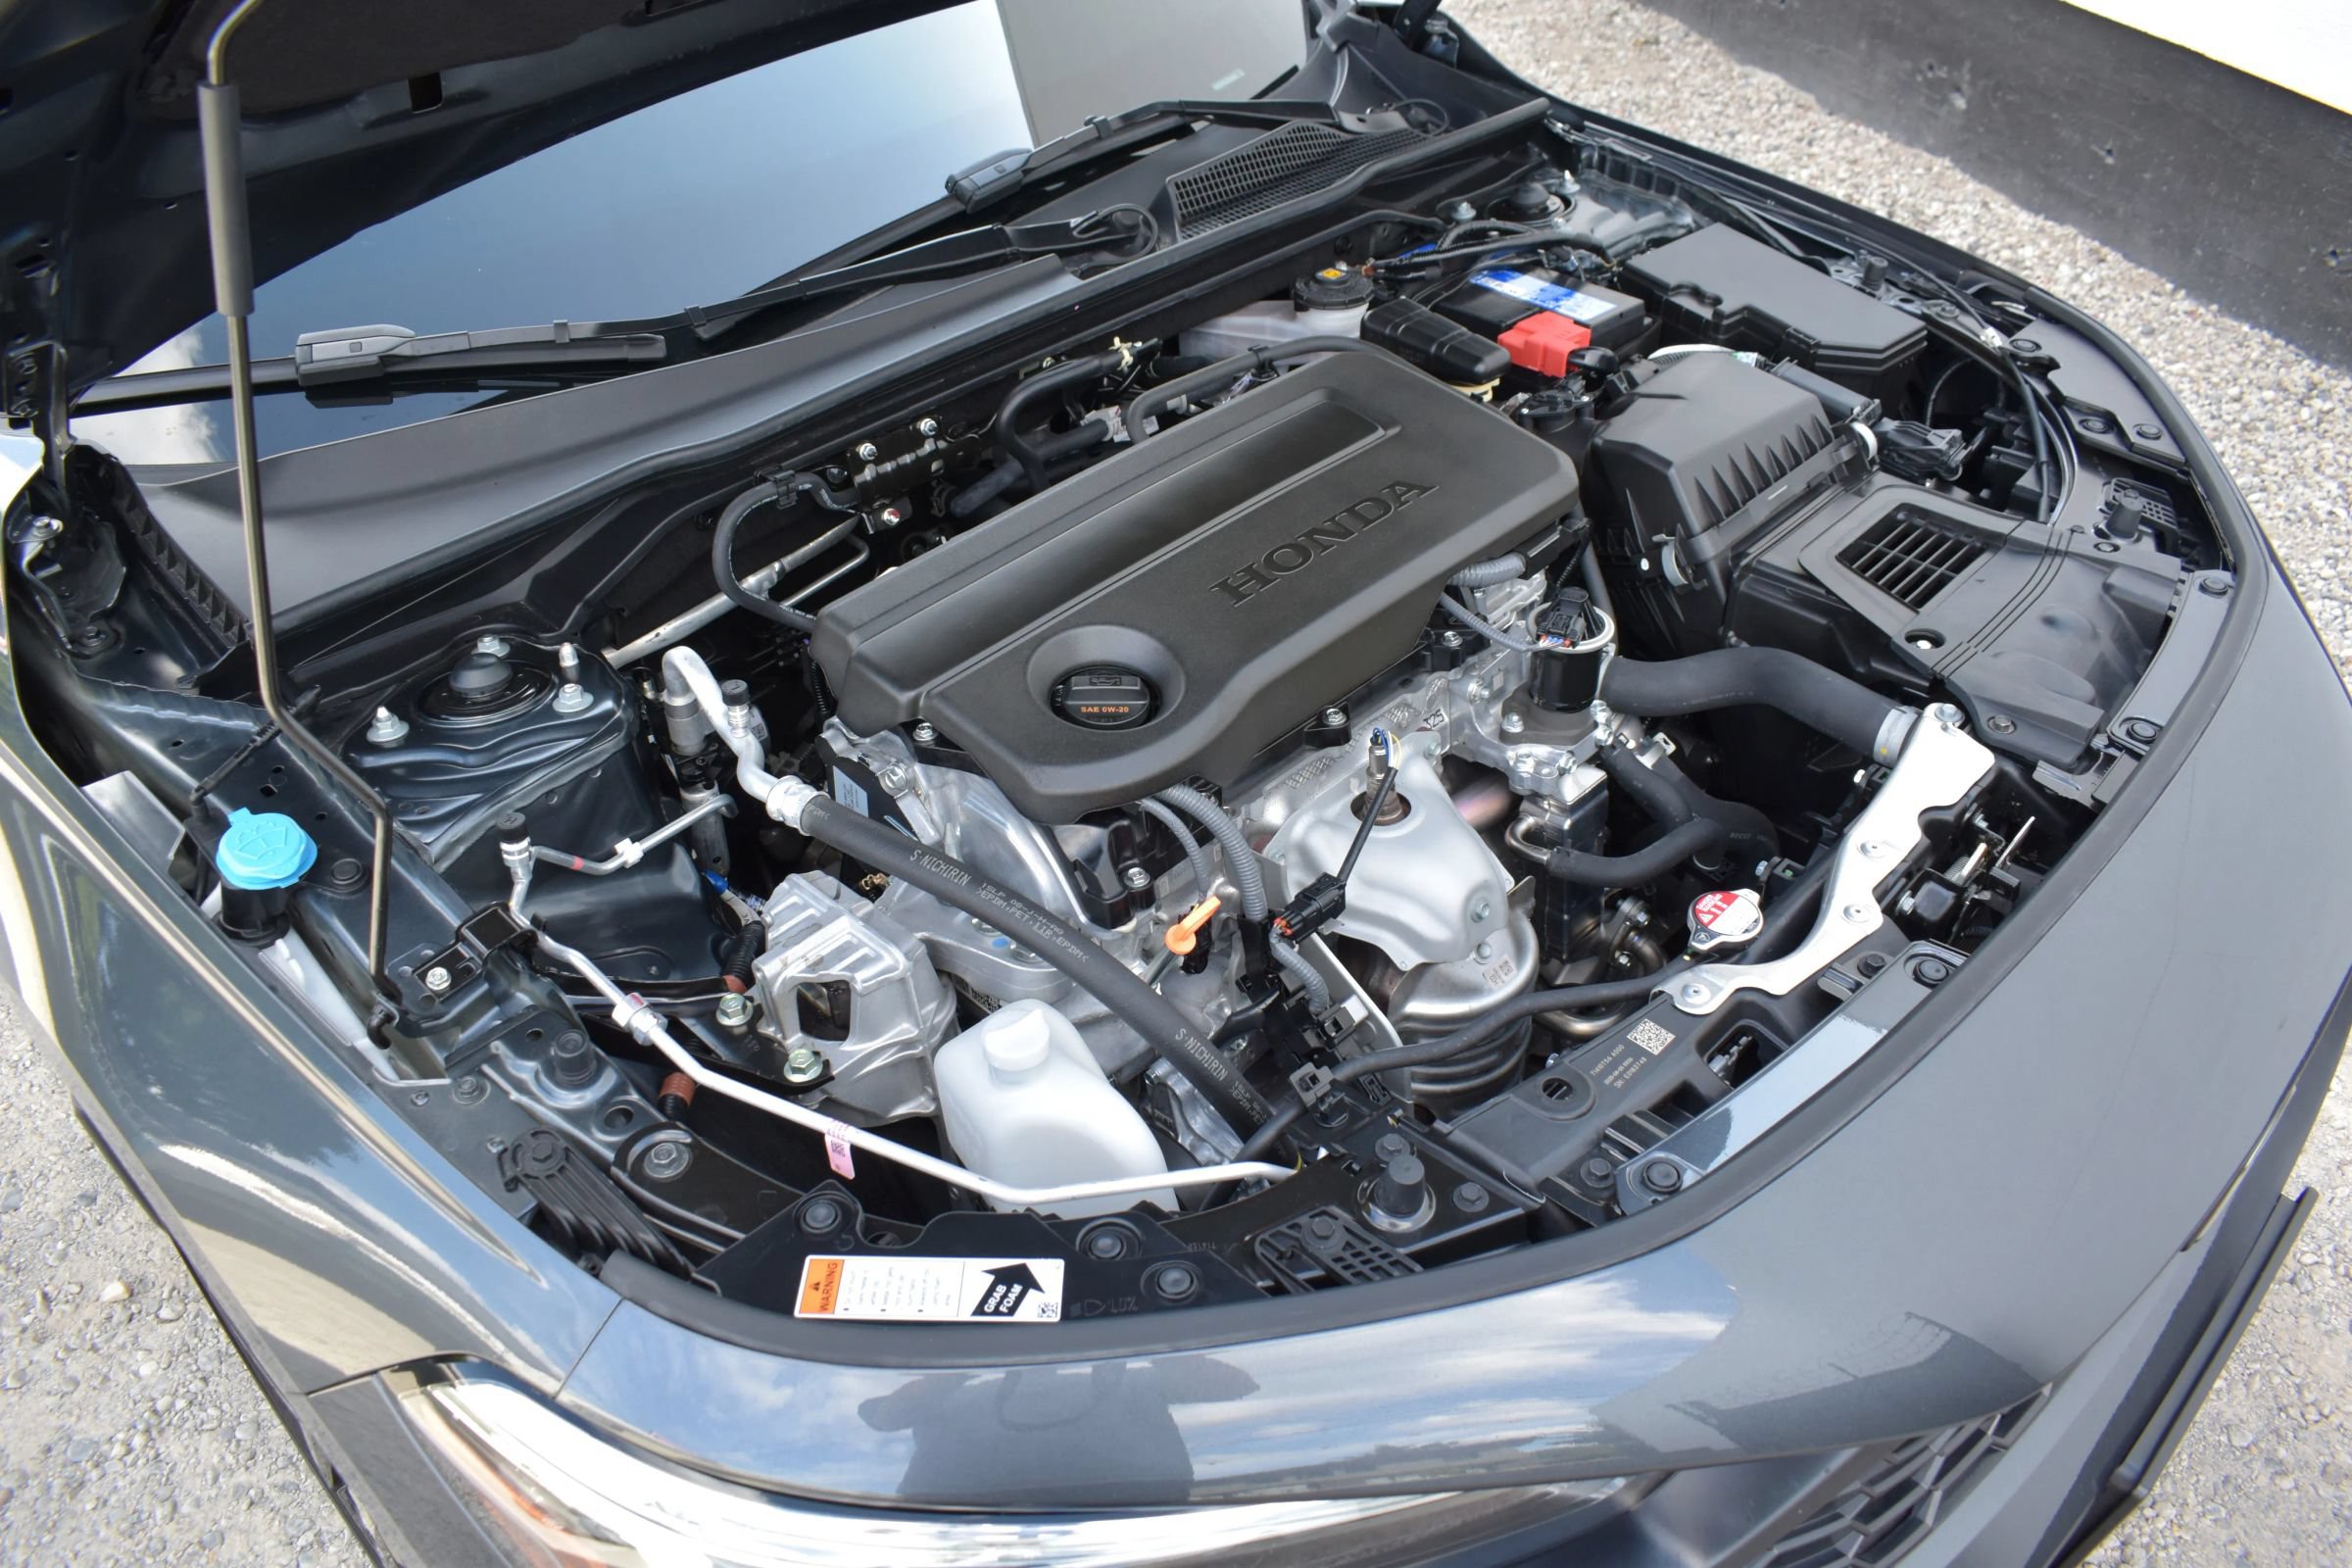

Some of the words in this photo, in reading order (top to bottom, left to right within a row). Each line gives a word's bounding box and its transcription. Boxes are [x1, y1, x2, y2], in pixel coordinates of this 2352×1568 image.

[1207, 480, 1440, 608] HONDA
[818, 1261, 839, 1313] WARNING
[983, 1283, 1007, 1313] GRAB
[999, 1283, 1022, 1314] FOAM
